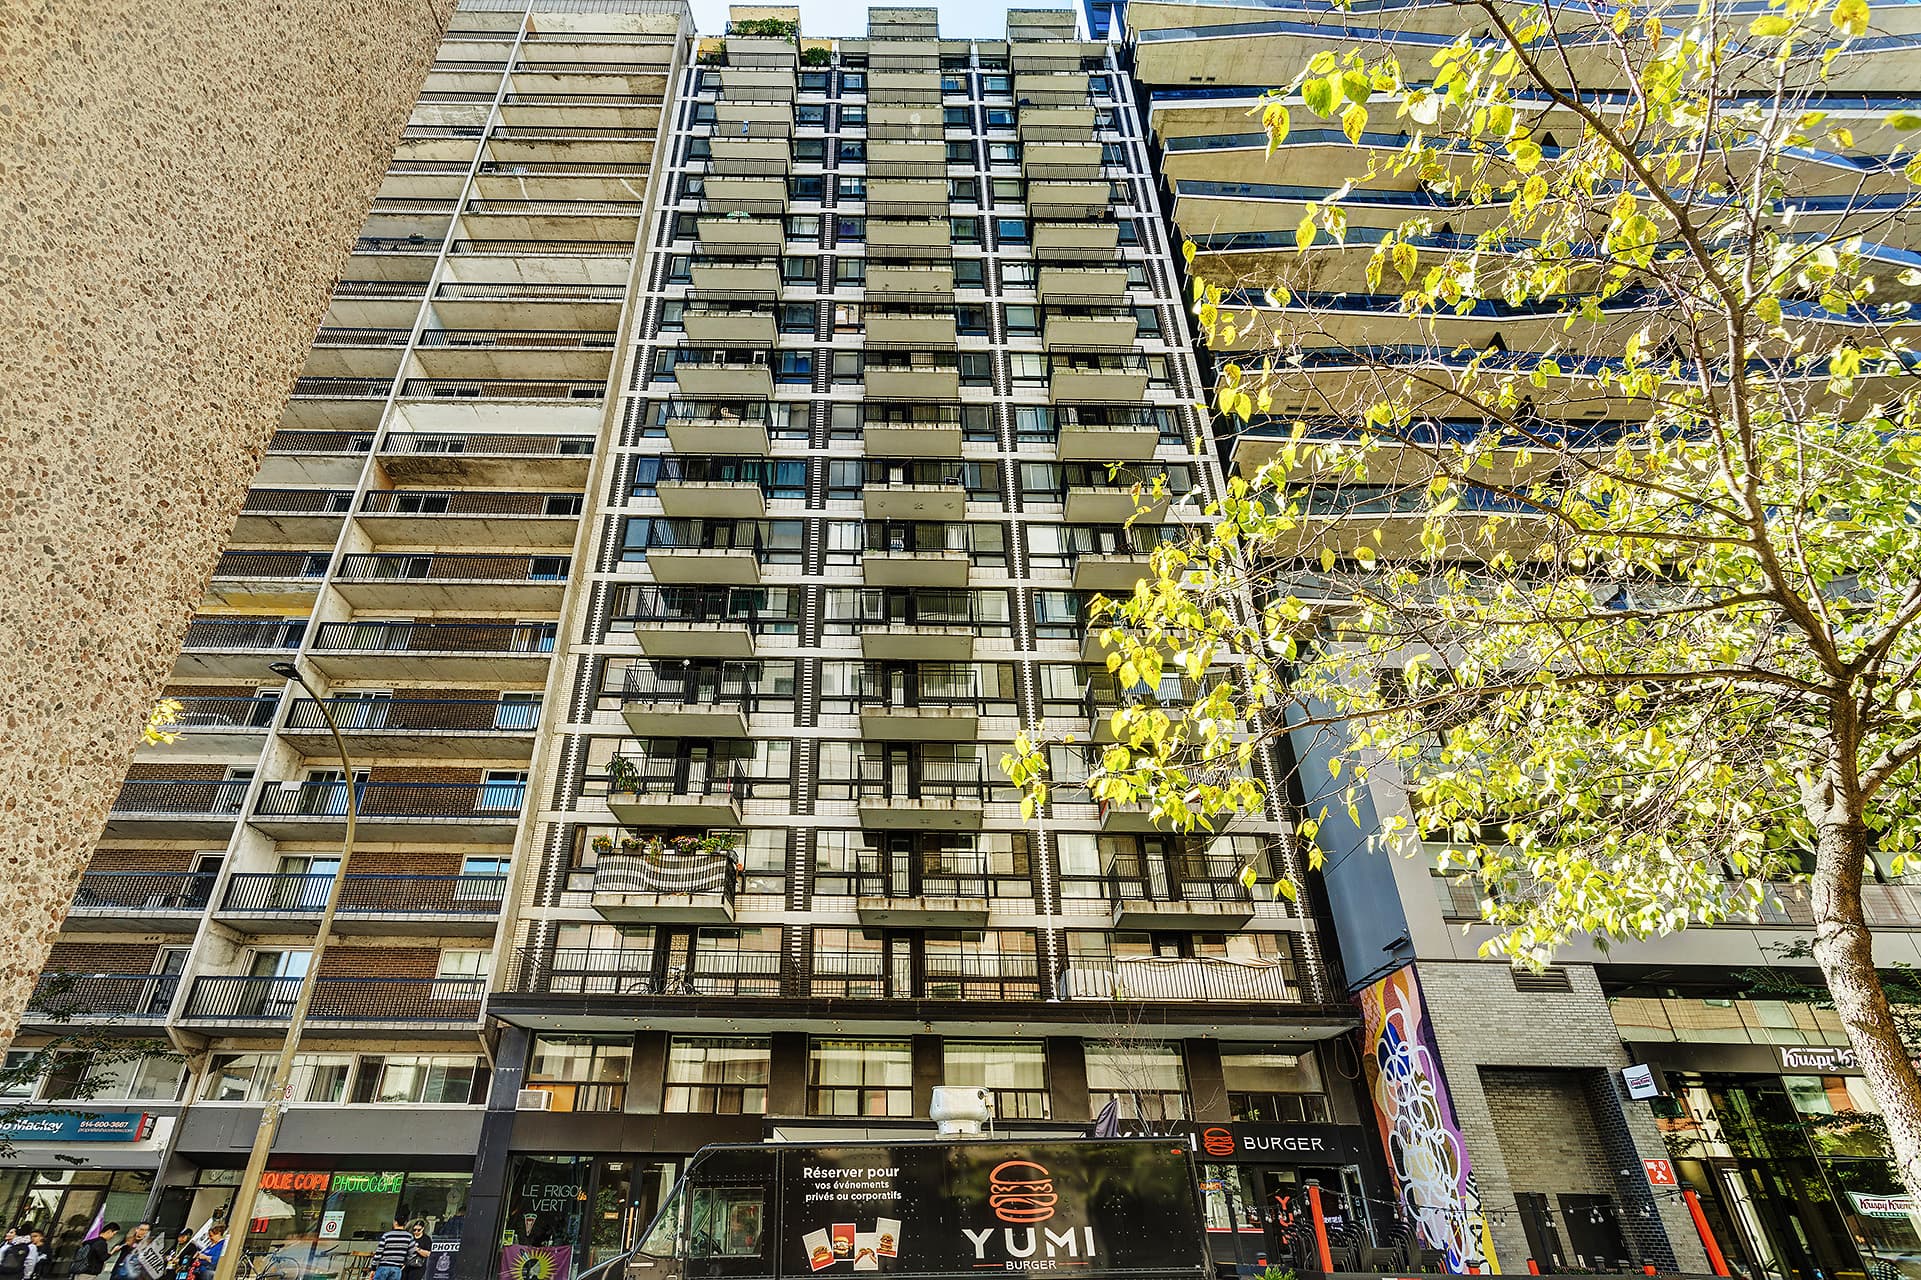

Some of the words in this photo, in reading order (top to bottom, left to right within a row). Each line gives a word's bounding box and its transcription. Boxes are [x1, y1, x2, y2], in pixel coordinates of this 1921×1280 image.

[1780, 1047, 1837, 1072] Krispy
[13, 1119, 63, 1134] Mackey
[1243, 1137, 1324, 1151] BURGER
[803, 1167, 864, 1179] Réserver
[867, 1167, 900, 1180] pour
[258, 1172, 292, 1191] JOLIE
[331, 1174, 402, 1193] PHOTOCOPIE
[815, 1182, 832, 1190] vos
[833, 1180, 890, 1190] événements
[521, 1184, 540, 1198] LE
[543, 1184, 580, 1198] FRIGO
[805, 1191, 835, 1203] privés
[850, 1190, 903, 1202] corporatifs
[532, 1199, 568, 1212] VERT
[1859, 1198, 1888, 1212] Krispy
[961, 1226, 1096, 1259] YUMI
[1005, 1260, 1057, 1270] BURGER
